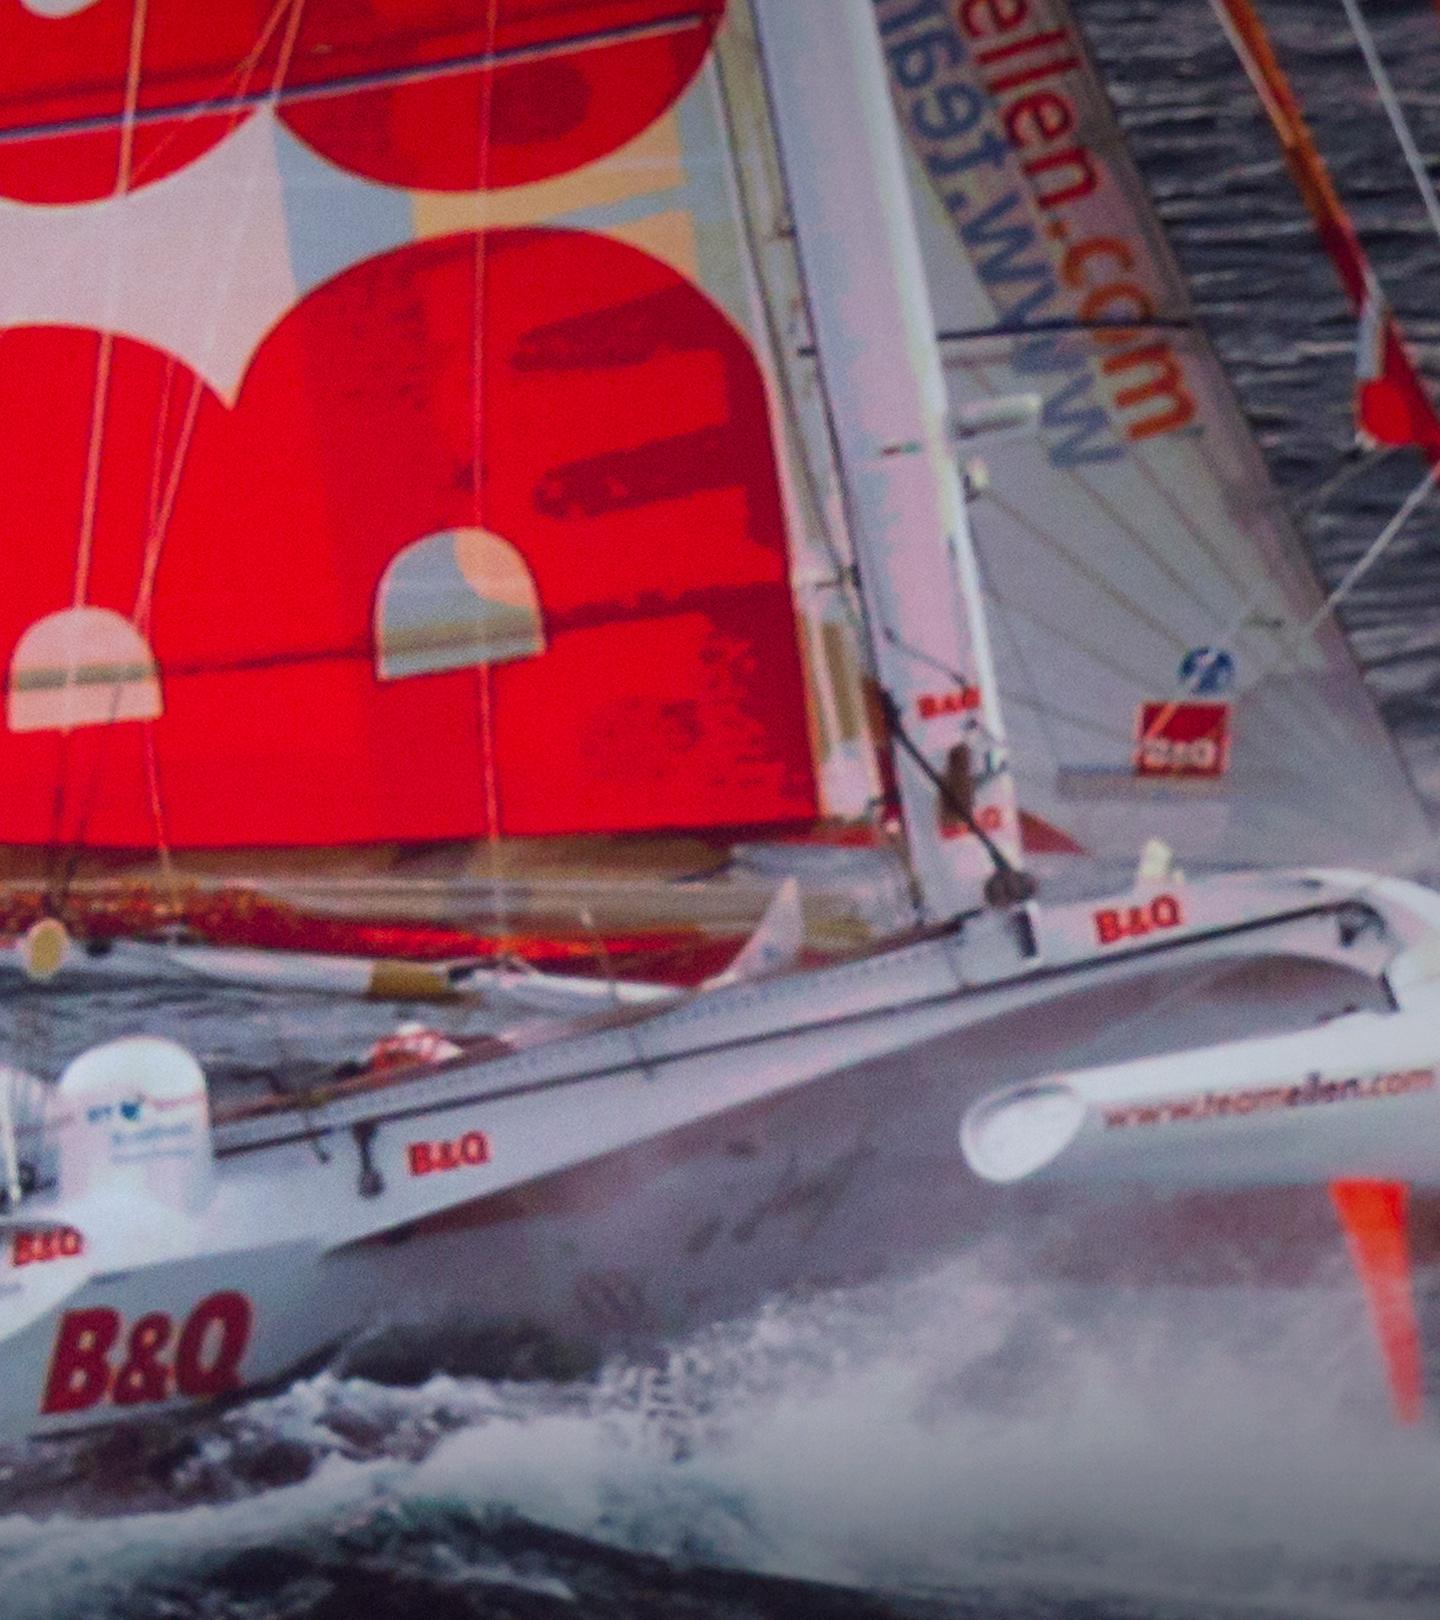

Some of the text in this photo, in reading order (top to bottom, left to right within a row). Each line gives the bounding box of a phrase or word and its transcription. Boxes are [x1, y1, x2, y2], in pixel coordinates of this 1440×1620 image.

[1095, 895, 1181, 945] B&Q
[408, 1131, 488, 1176] B&Q
[13, 1226, 84, 1267] B&Q
[41, 1290, 252, 1415] B&Q
